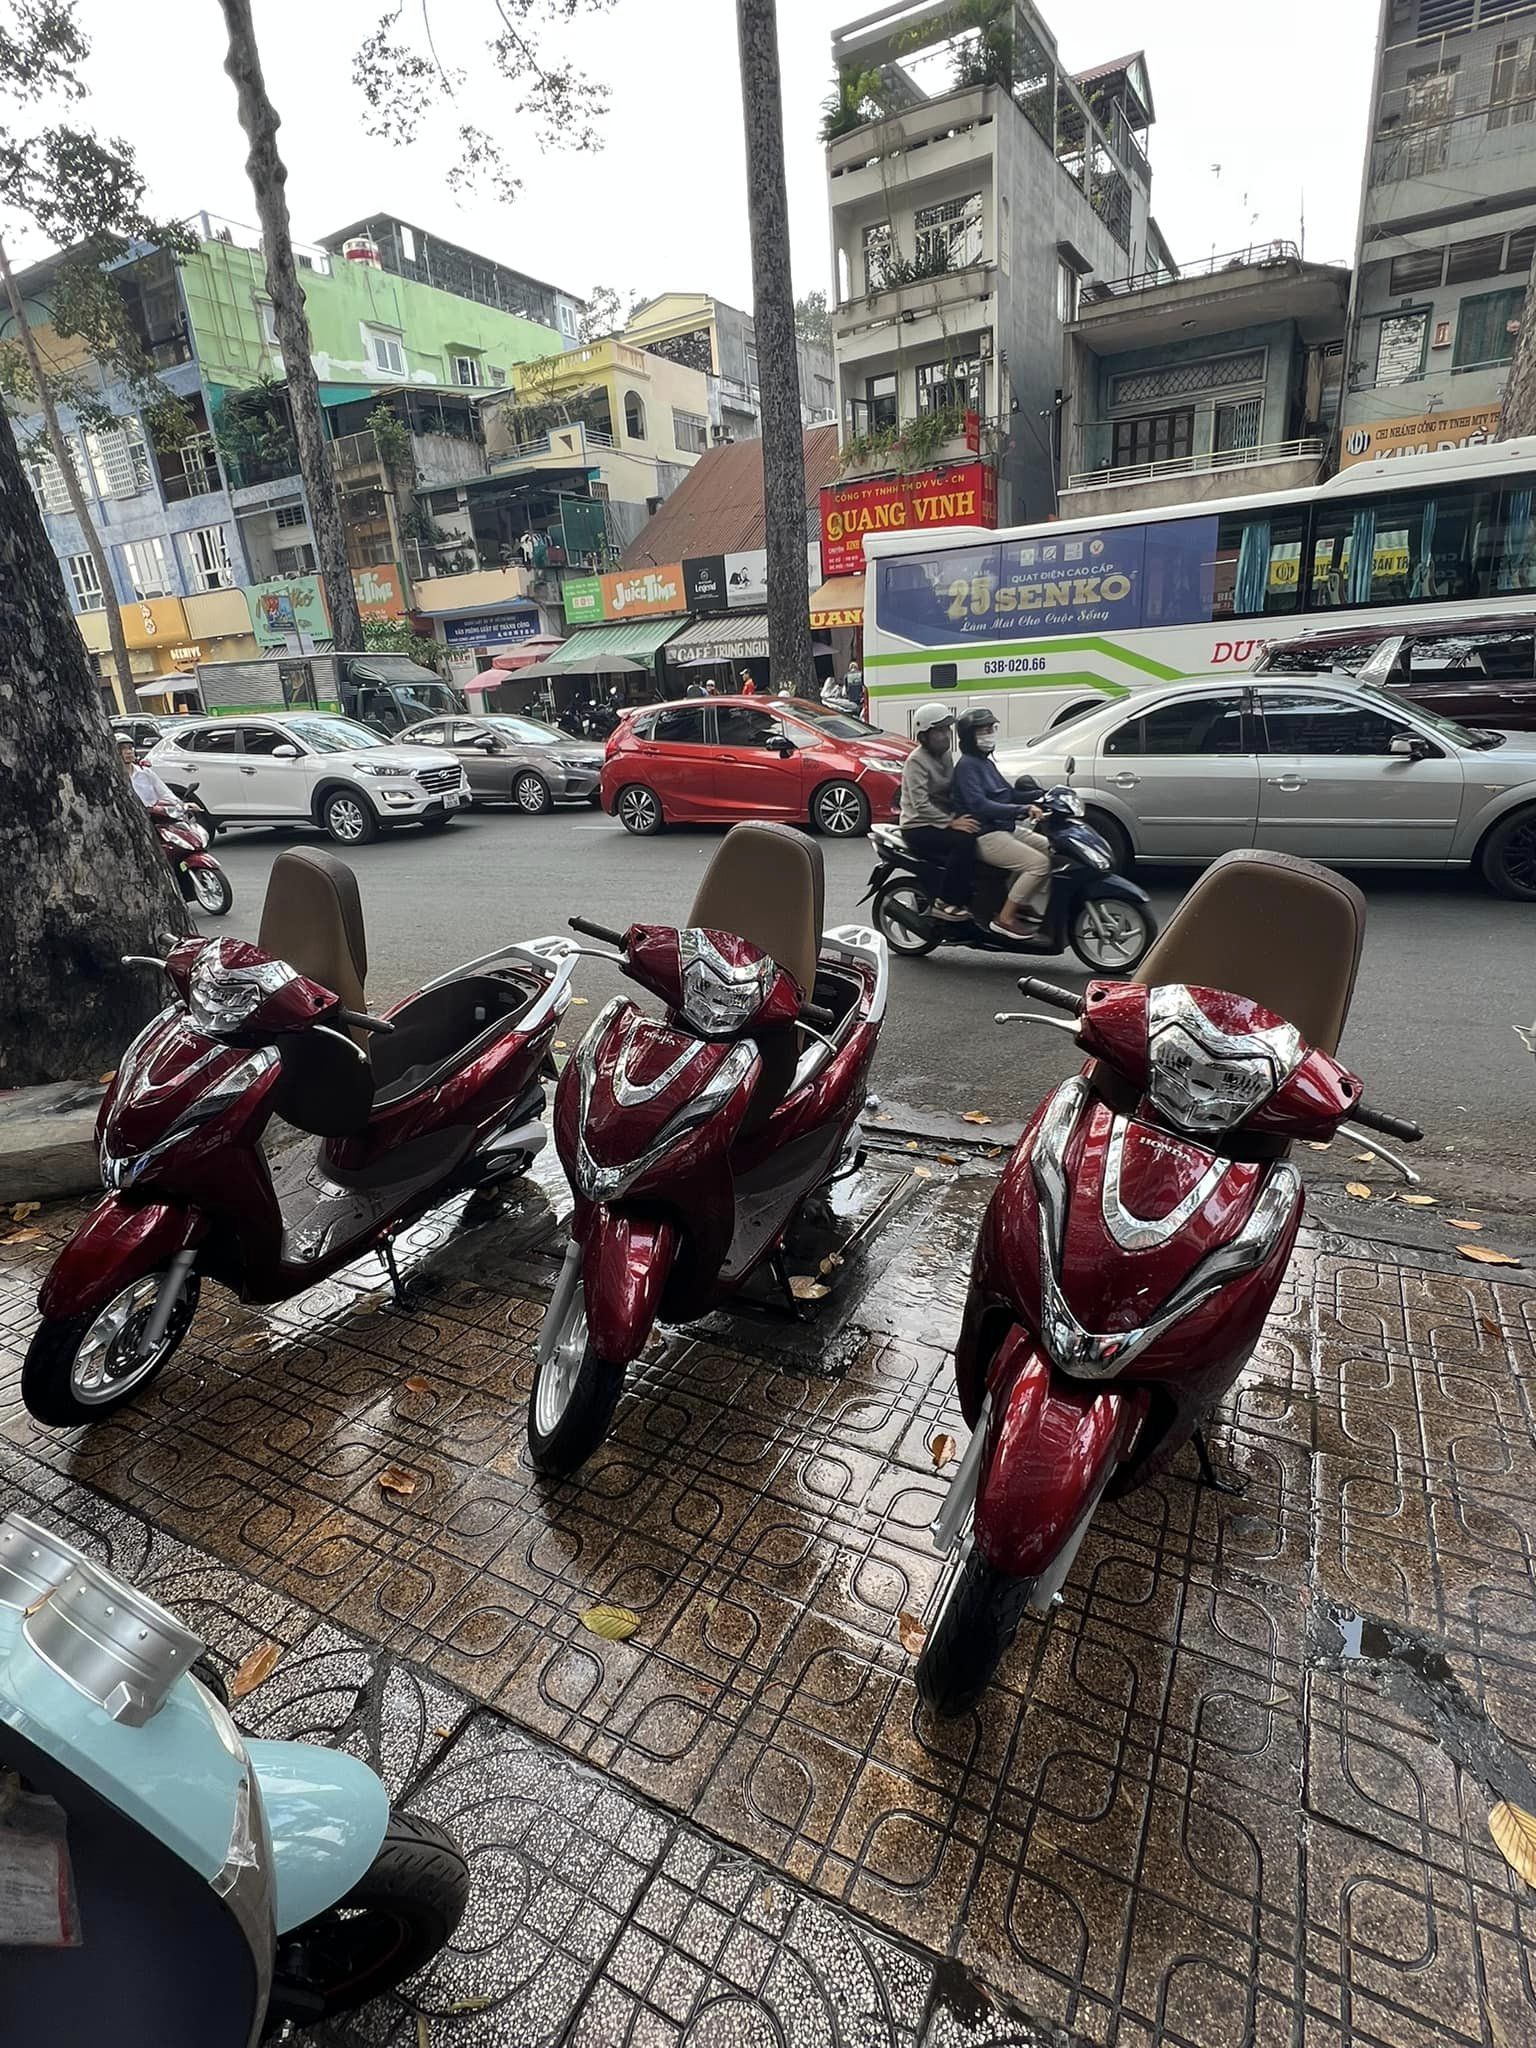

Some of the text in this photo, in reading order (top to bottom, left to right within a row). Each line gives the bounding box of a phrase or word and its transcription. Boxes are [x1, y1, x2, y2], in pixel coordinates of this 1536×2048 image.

[1376, 429, 1388, 440] CHI
[1438, 419, 1447, 431] TY
[1449, 416, 1471, 429] TNHH
[862, 489, 873, 499] TY
[875, 485, 898, 497] TNHH
[951, 474, 965, 484] CN
[826, 501, 907, 542] QUANG
[912, 490, 976, 522] VINH
[1067, 567, 1089, 577] CAO
[1090, 562, 1114, 574] CẤP
[946, 577, 991, 618] 25
[994, 574, 1131, 614] SENKO
[809, 608, 864, 627] UAN
[713, 642, 744, 658] TRUNG
[744, 640, 770, 657] NGUY
[1139, 1136, 1192, 1162] HONDA
